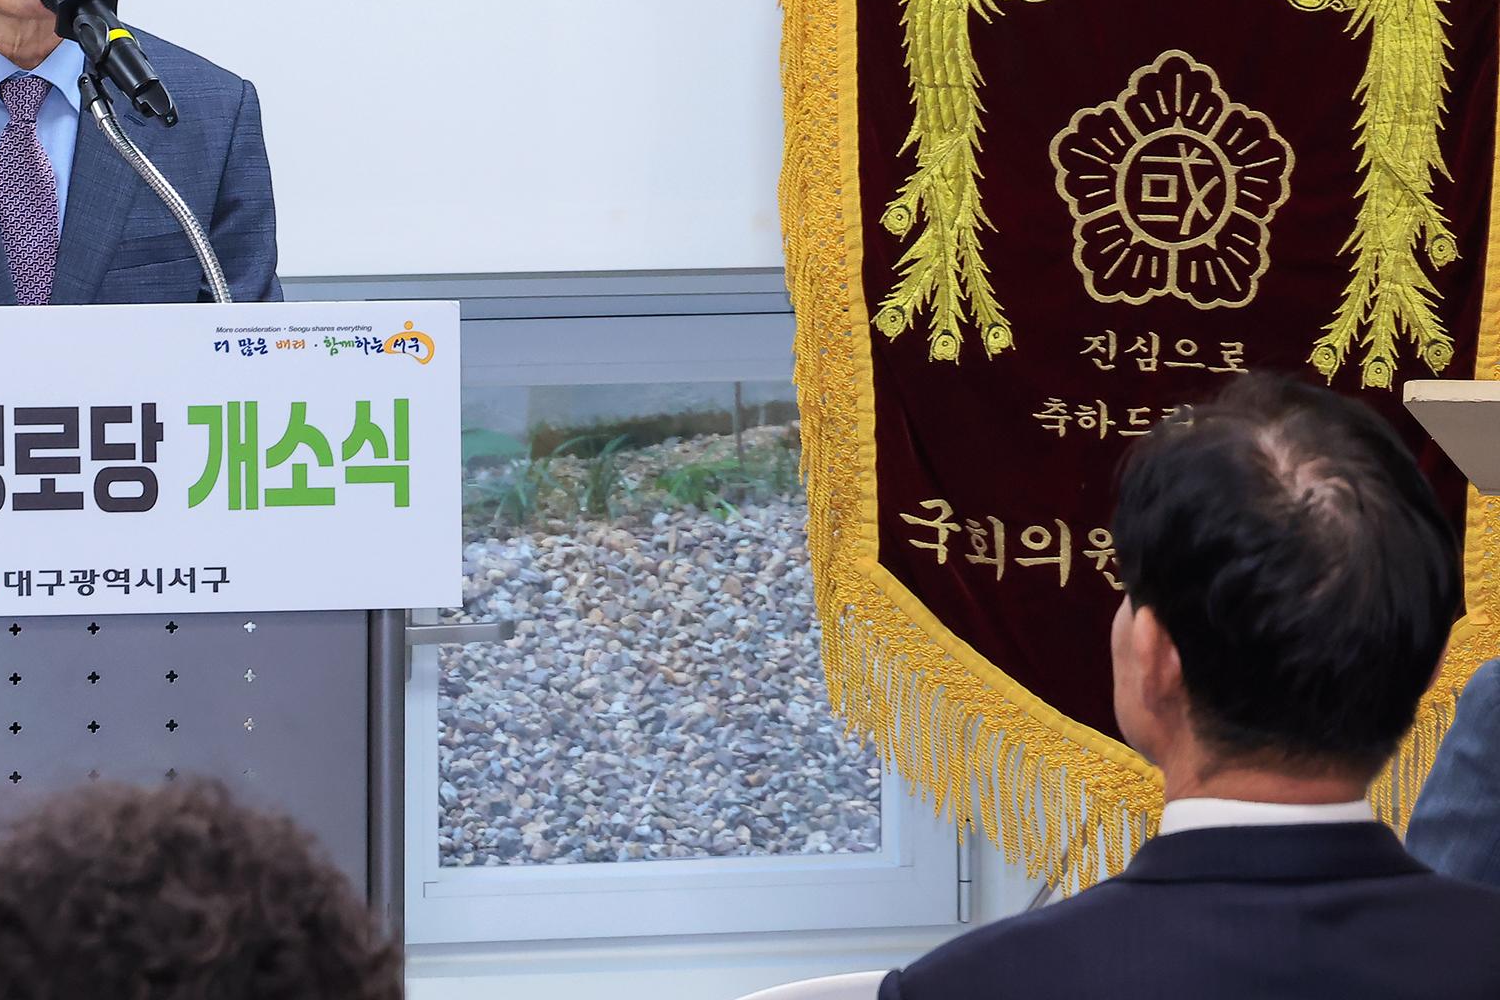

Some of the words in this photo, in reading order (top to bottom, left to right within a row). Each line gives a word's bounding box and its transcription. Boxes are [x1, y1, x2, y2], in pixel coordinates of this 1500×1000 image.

[288, 326, 311, 335] Seogu
[336, 325, 373, 333] everything
[214, 339, 230, 353] 더
[237, 337, 269, 356] 많은
[275, 339, 306, 350] 배려
[1079, 329, 1250, 375] 진심으로
[187, 398, 410, 511] 개소식
[3, 566, 231, 597] 대구광역시서구
